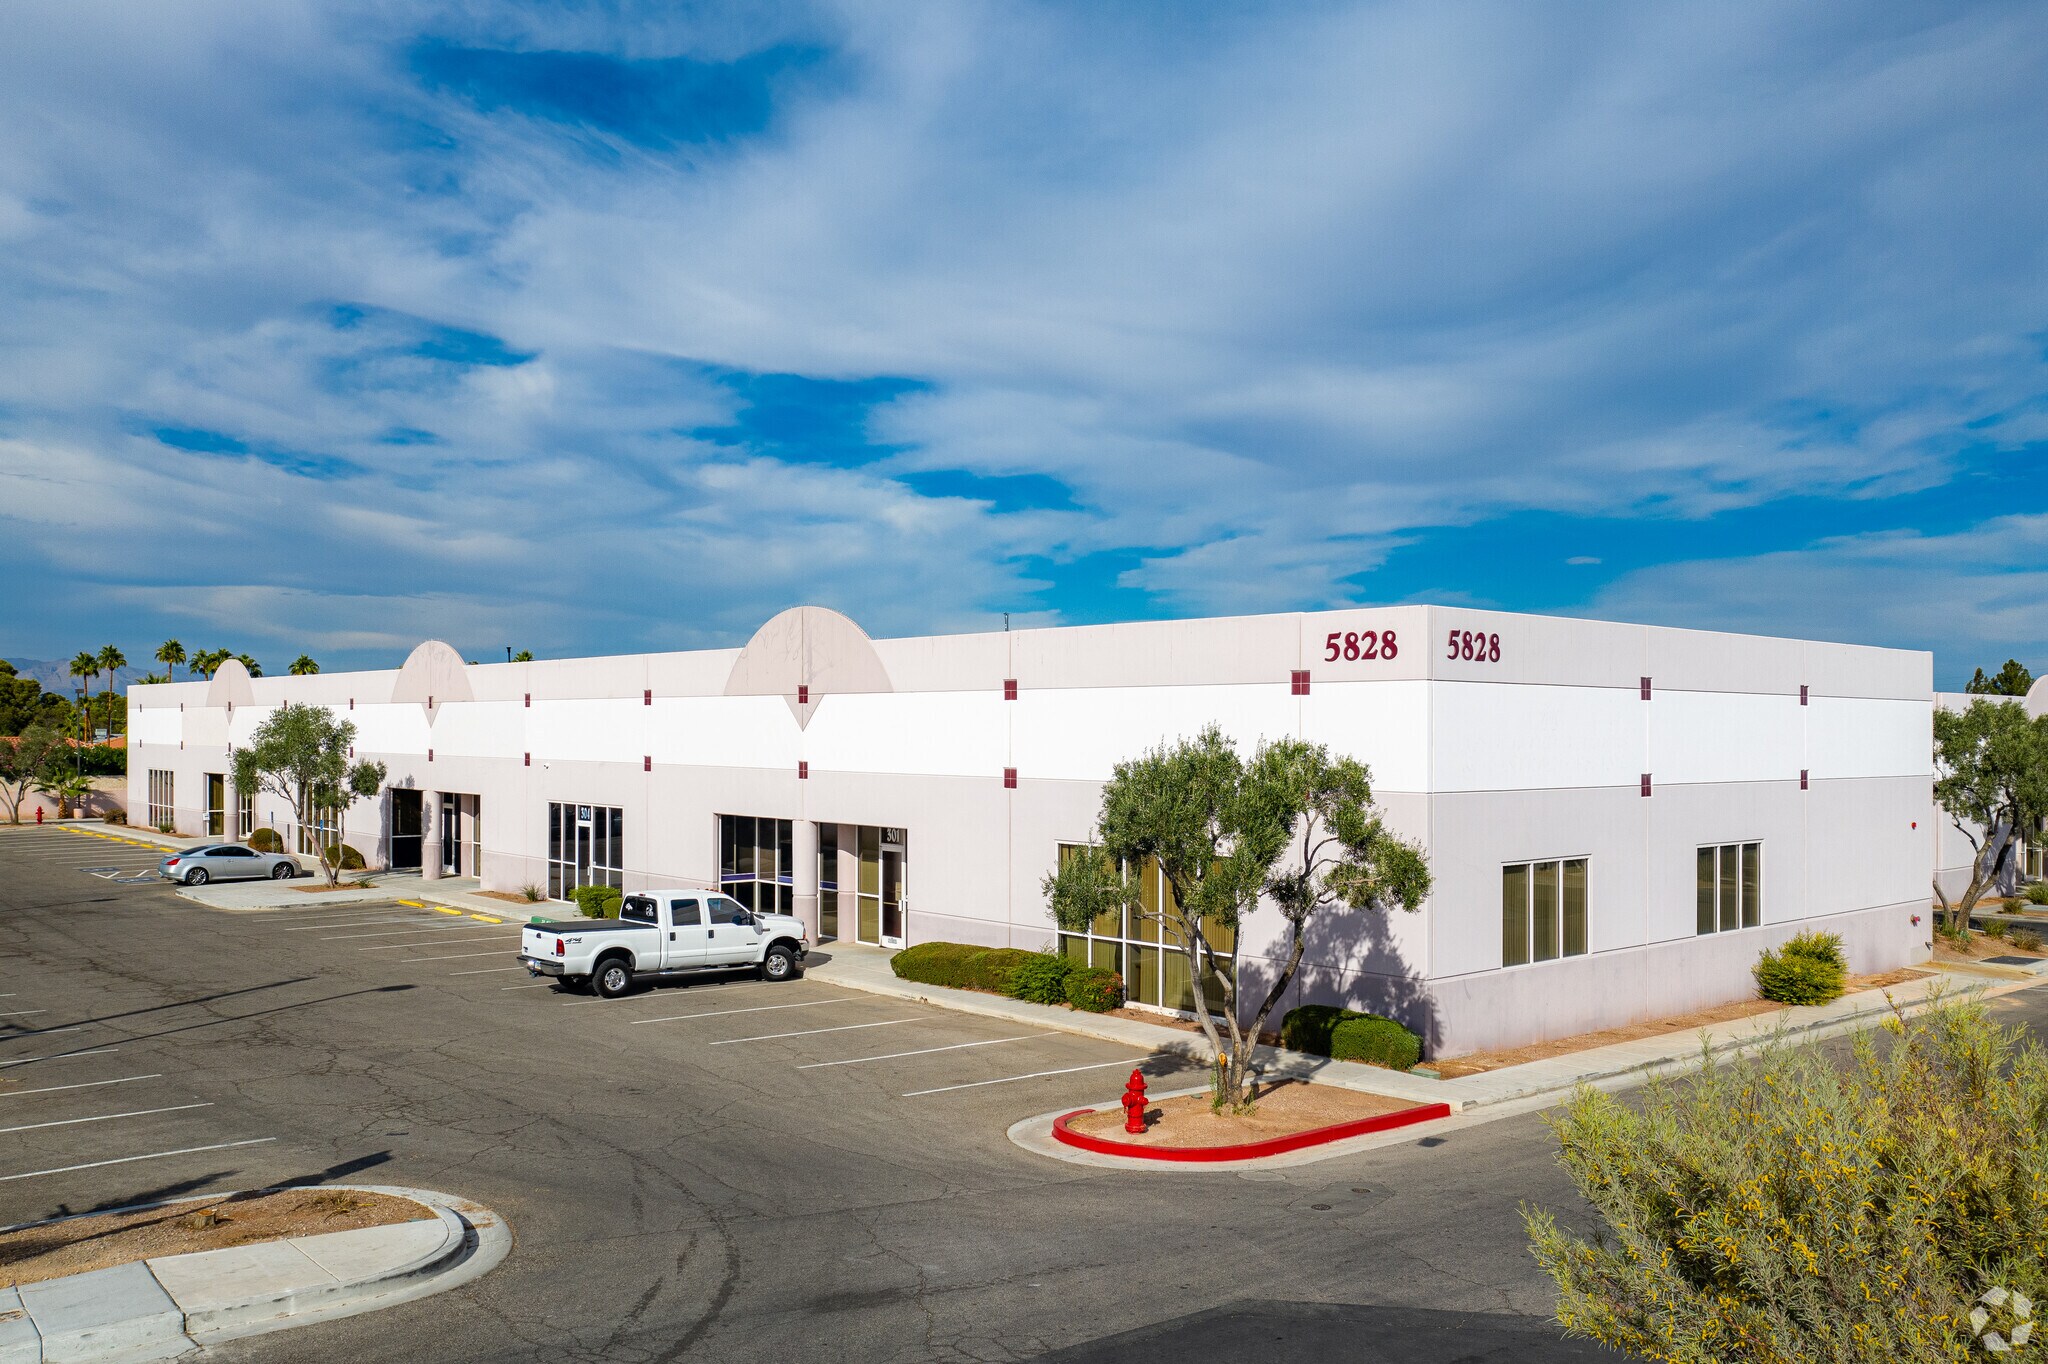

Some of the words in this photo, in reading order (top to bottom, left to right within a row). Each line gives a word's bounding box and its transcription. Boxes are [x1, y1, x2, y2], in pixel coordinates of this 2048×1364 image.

[1324, 630, 1398, 662] 5828
[1447, 629, 1500, 662] 5828
[887, 828, 899, 842] 301
